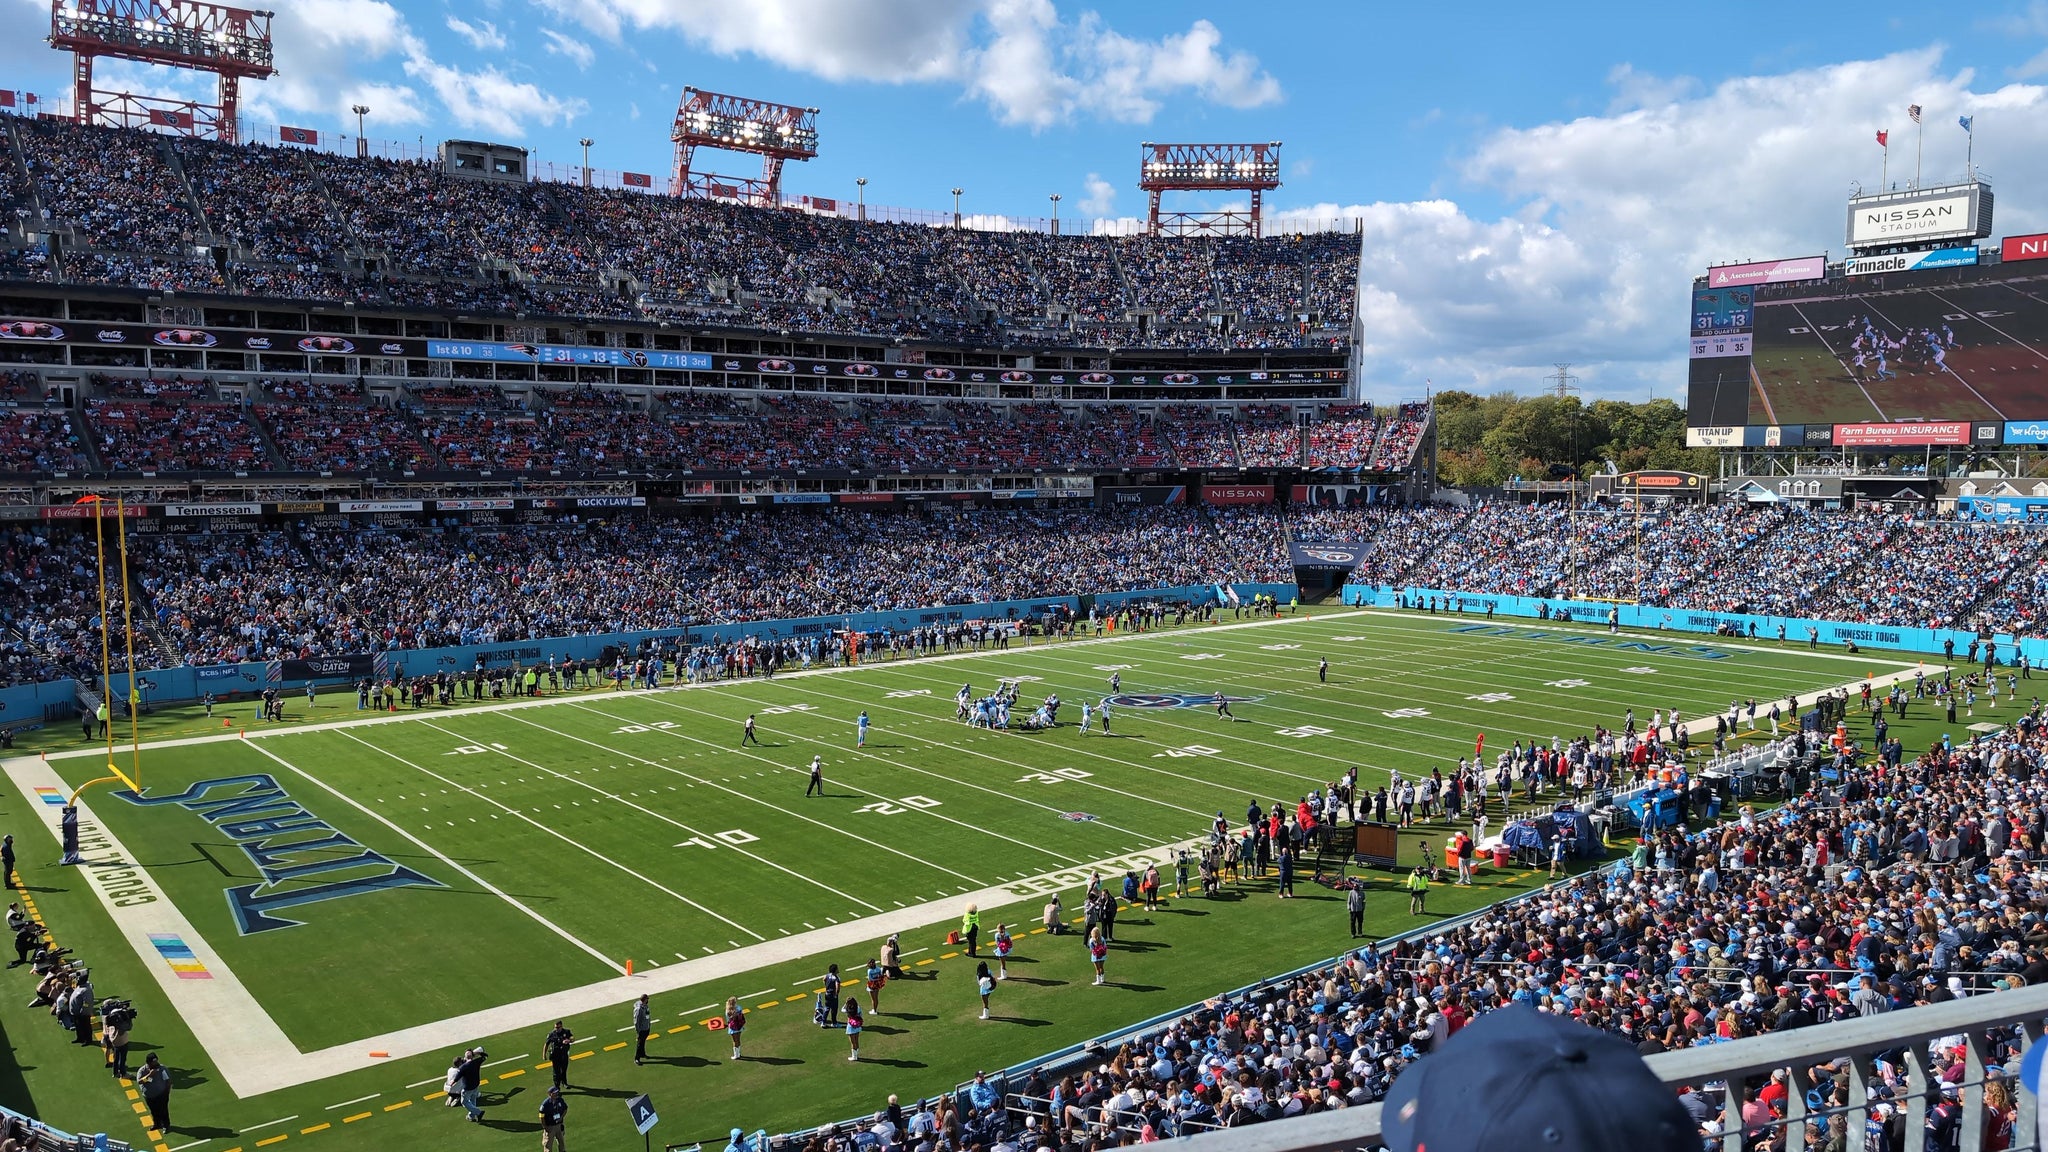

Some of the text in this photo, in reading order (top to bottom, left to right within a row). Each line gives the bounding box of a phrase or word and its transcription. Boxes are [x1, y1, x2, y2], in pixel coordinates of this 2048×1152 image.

[1868, 206, 1952, 224] NISSAN
[1880, 220, 1937, 232] STADIUM
[1847, 257, 1906, 274] Pinnacle
[1920, 258, 1975, 268] TitansBanking.com
[1730, 265, 1811, 279] Ascension Saint Thomas
[1698, 314, 1745, 328] 31 13
[435, 345, 472, 355] 1st & 10
[482, 349, 493, 357] 35
[558, 351, 571, 361] 31
[1695, 346, 1706, 354] 1ST
[594, 352, 605, 362] 13
[661, 354, 707, 366] 7:18 3rd
[1697, 428, 1720, 436] TITAN
[1767, 429, 1779, 438] Lite
[1841, 425, 1960, 435] Farm Bureau INSURANCE
[792, 495, 823, 503] Gallagher
[1212, 490, 1265, 498] NISSAN
[532, 500, 557, 508] FedEx
[577, 498, 607, 506] ROCKY
[54, 508, 82, 517] Coca-Cola
[1567, 606, 1596, 617] TENNESSEE
[1688, 616, 1721, 629] TENNESSEE
[793, 625, 823, 635] TENNESSEE
[1834, 628, 1900, 643] TENNESSEE TOUGH
[322, 663, 350, 672] CATCH
[1274, 725, 1335, 738] 50
[1165, 745, 1222, 758] 40
[1022, 767, 1095, 785] 30
[866, 795, 944, 815] 20
[688, 829, 760, 850] 10
[108, 773, 452, 937] TITANS
[87, 851, 158, 908] CRUCIAL
[1817, 1007, 1826, 1023] 0
[640, 1106, 650, 1121] A
[922, 1119, 933, 1132] 10
